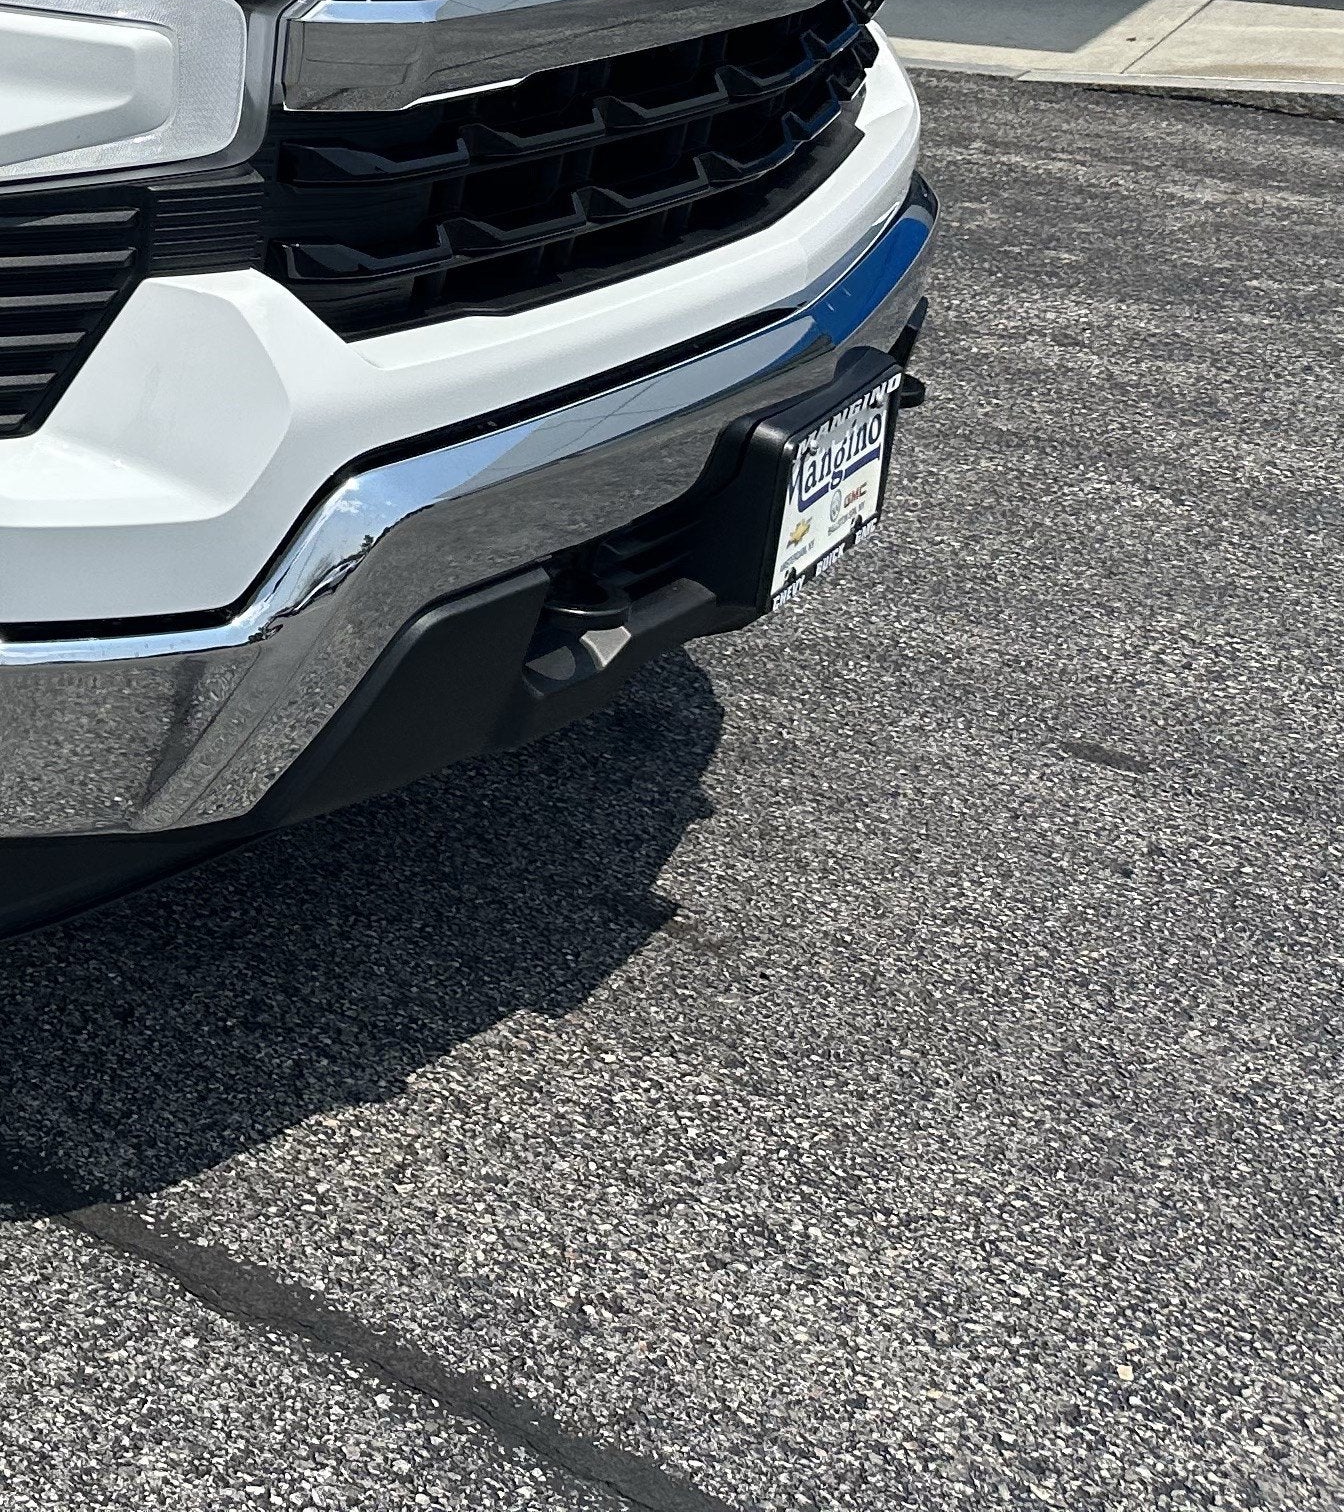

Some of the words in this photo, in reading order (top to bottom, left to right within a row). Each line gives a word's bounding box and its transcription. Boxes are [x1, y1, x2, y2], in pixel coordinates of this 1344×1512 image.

[795, 372, 902, 458] MANGINO
[787, 413, 882, 512] Mangino
[843, 481, 867, 508] GMC
[772, 574, 805, 612] CHEVY
[815, 543, 845, 577] BUICK
